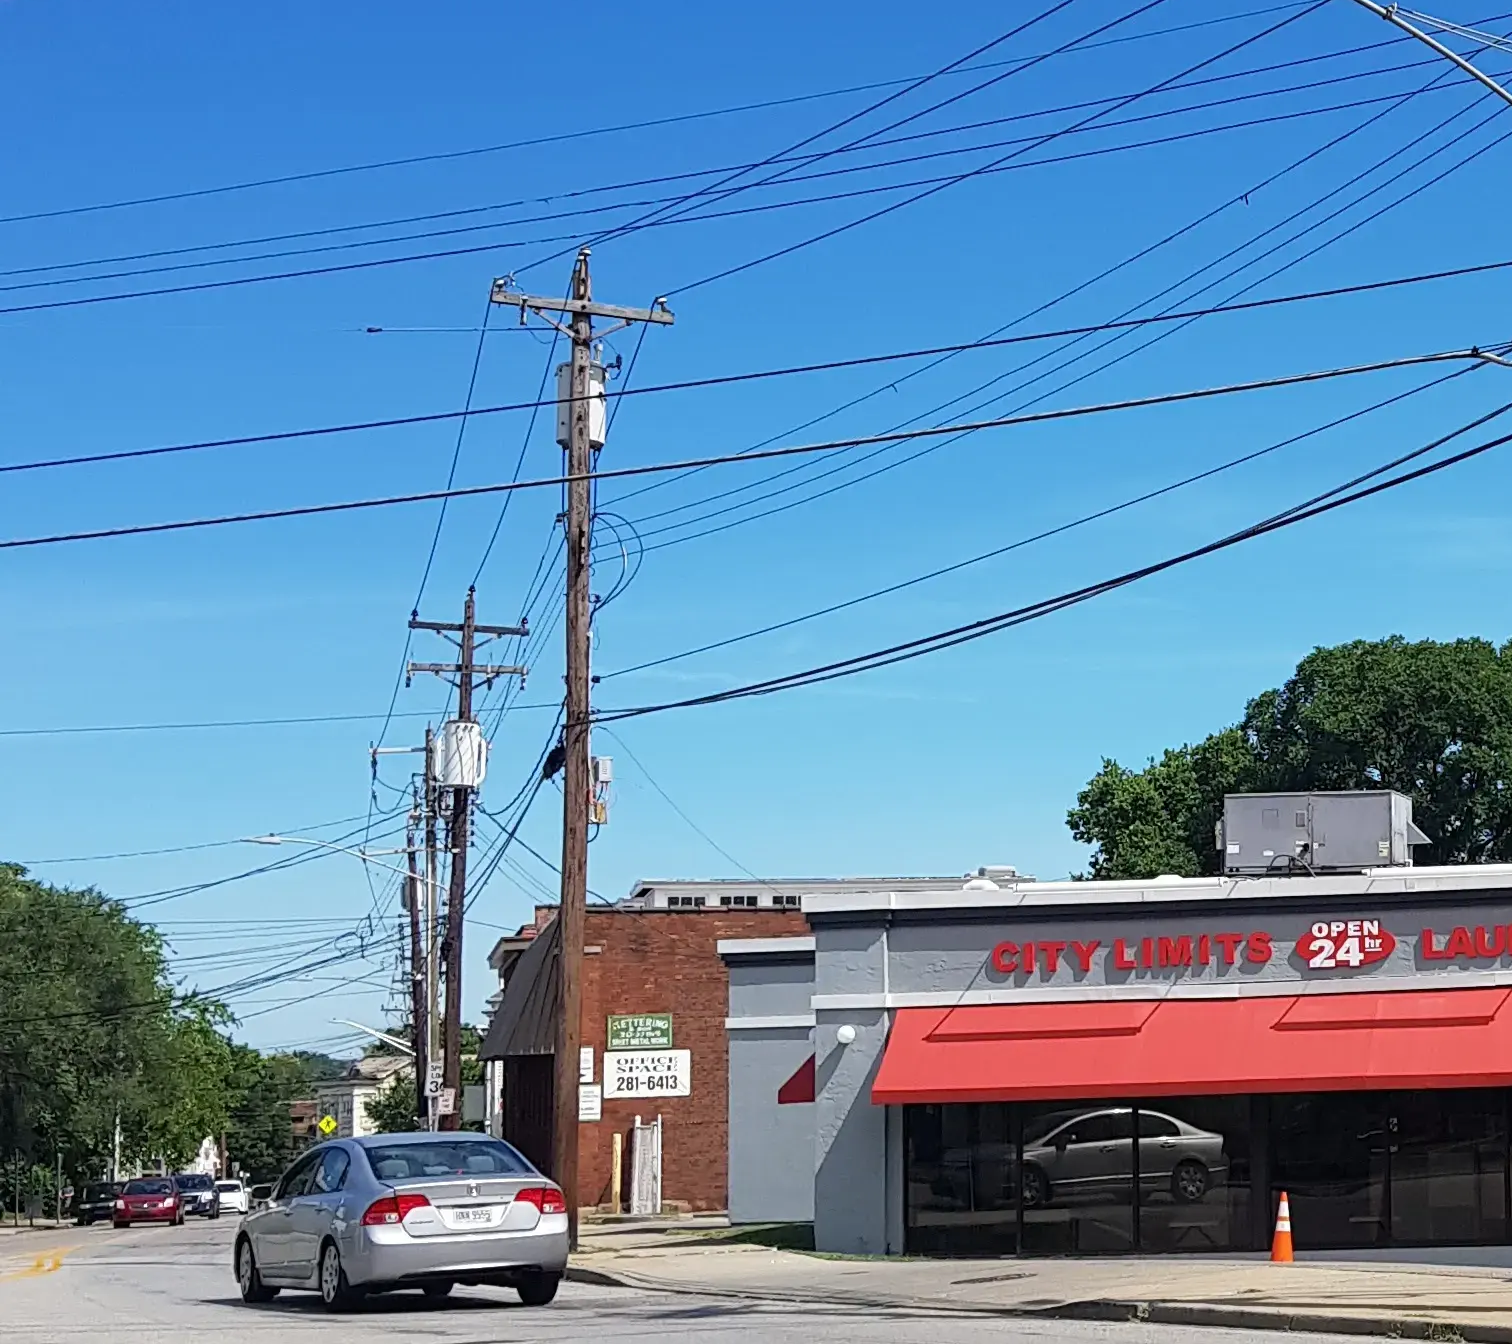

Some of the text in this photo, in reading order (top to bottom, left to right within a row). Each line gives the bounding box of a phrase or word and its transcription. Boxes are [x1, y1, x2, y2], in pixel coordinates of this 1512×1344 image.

[1312, 921, 1378, 938] OPEN
[991, 931, 1273, 974] CITY LIMITS
[1309, 938, 1364, 968] 24
[616, 1056, 678, 1065] OFFICE
[616, 1064, 678, 1073] SPACE
[616, 1074, 678, 1091] 281-6413
